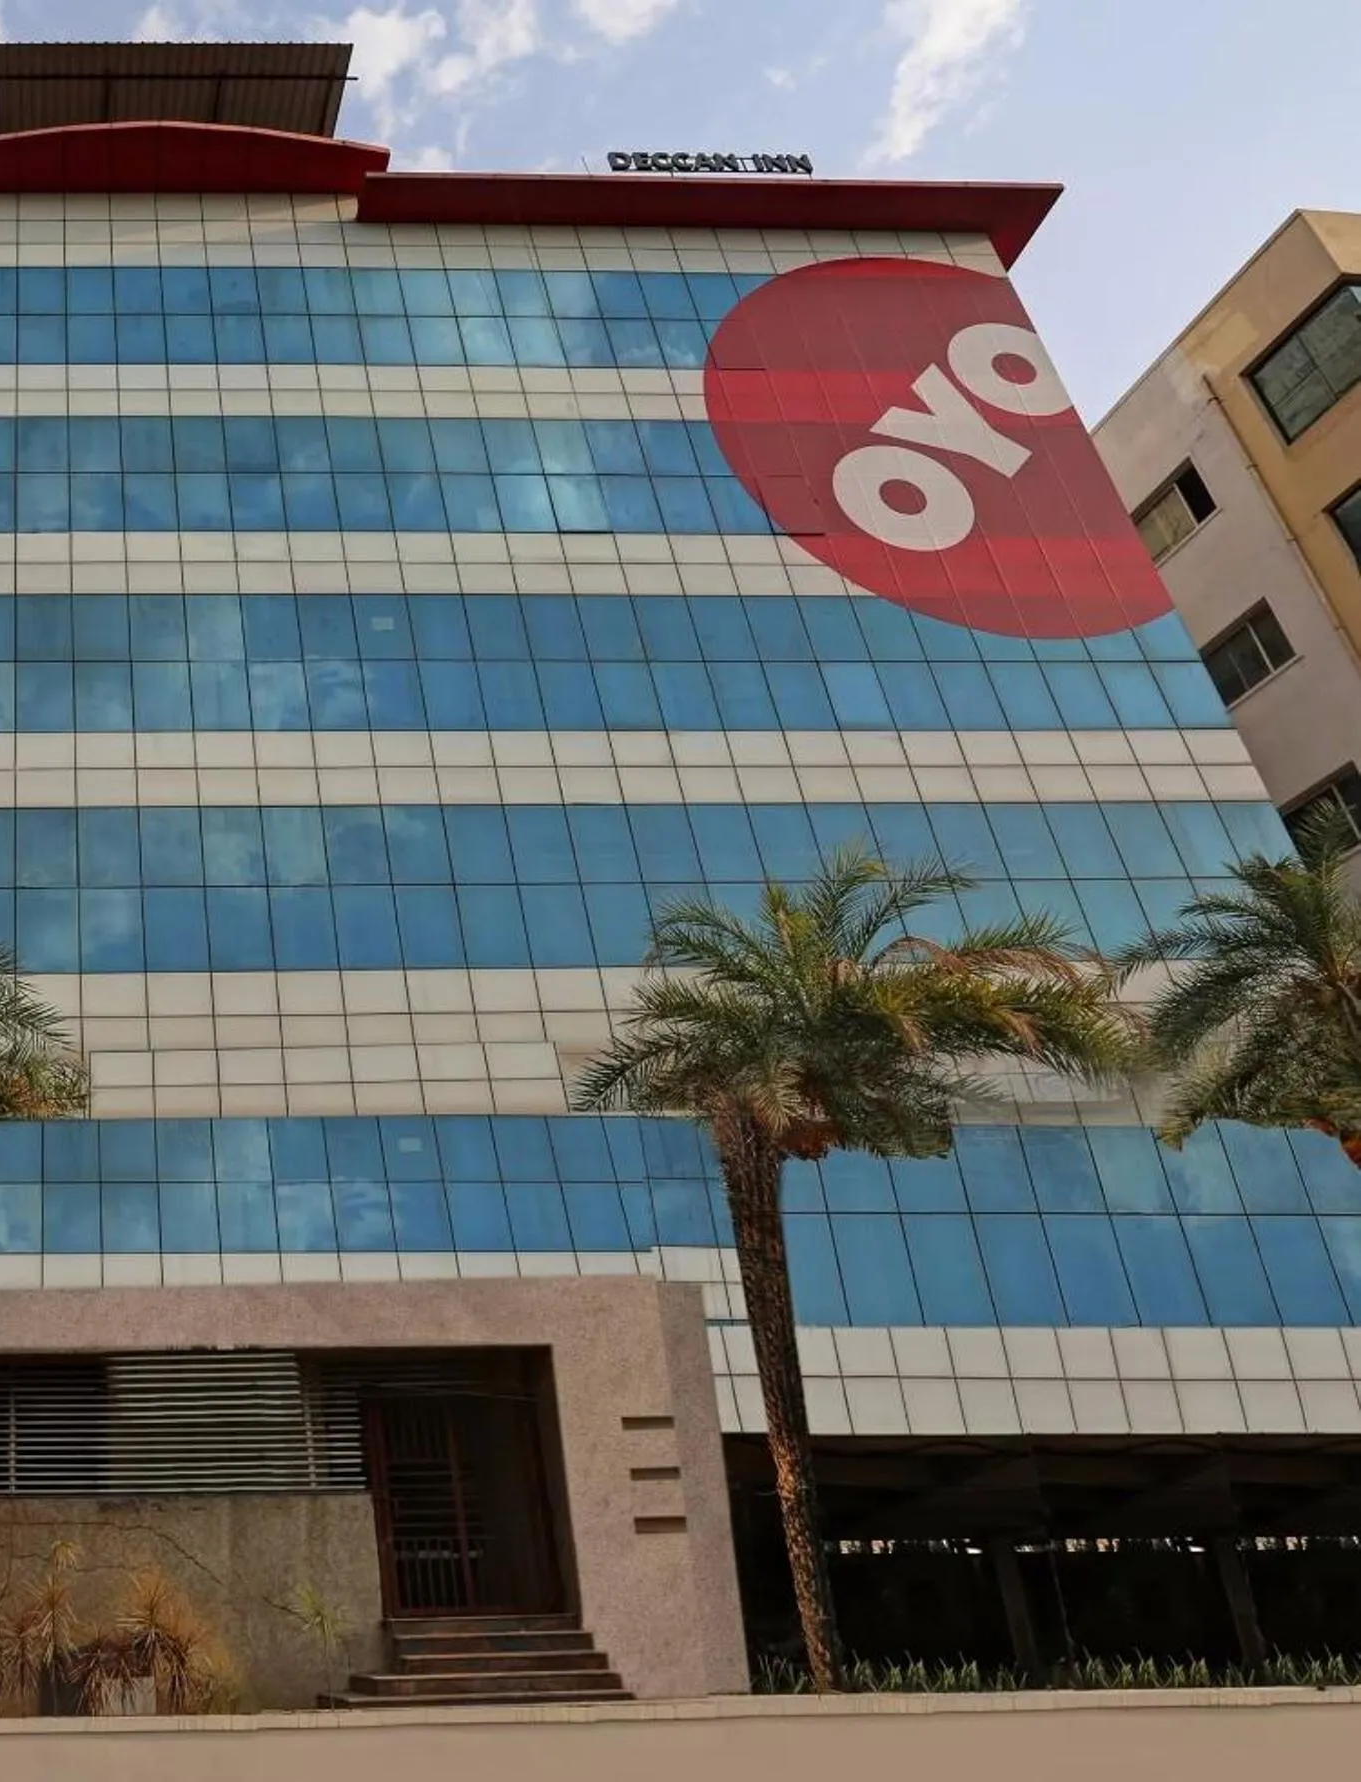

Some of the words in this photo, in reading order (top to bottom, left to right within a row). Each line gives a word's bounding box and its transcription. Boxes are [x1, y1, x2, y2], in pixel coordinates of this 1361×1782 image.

[607, 151, 740, 172] DECCAN
[751, 153, 814, 173] INN
[832, 322, 1075, 551] OYO
